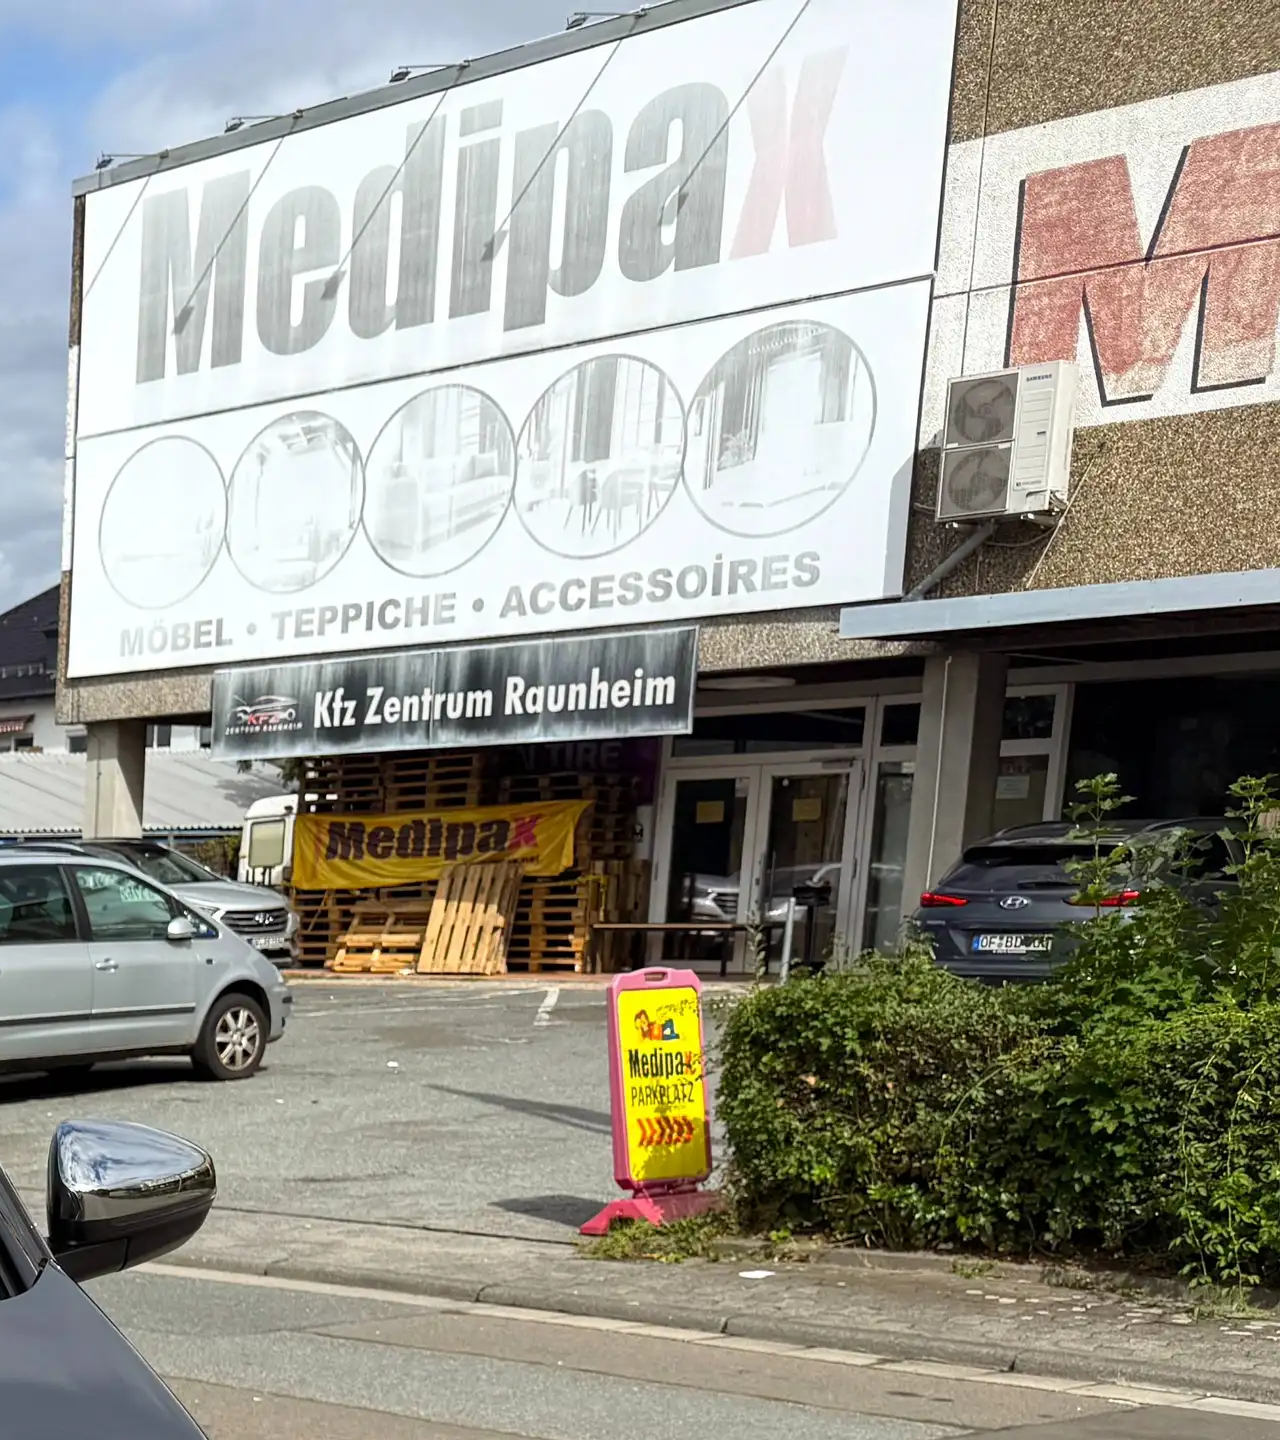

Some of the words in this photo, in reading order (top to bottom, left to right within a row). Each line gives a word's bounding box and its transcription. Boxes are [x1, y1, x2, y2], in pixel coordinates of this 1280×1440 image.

[136, 46, 849, 384] Medipax
[119, 620, 233, 658] MÖBEL
[271, 592, 457, 641] TEPPICHE
[314, 687, 357, 729] Kfz
[364, 686, 493, 725] Zentrum
[505, 667, 676, 715] Raunheim
[326, 814, 544, 861] Medipax
[628, 1048, 697, 1080] Medipax
[631, 1082, 695, 1107] PARKPLATZ
